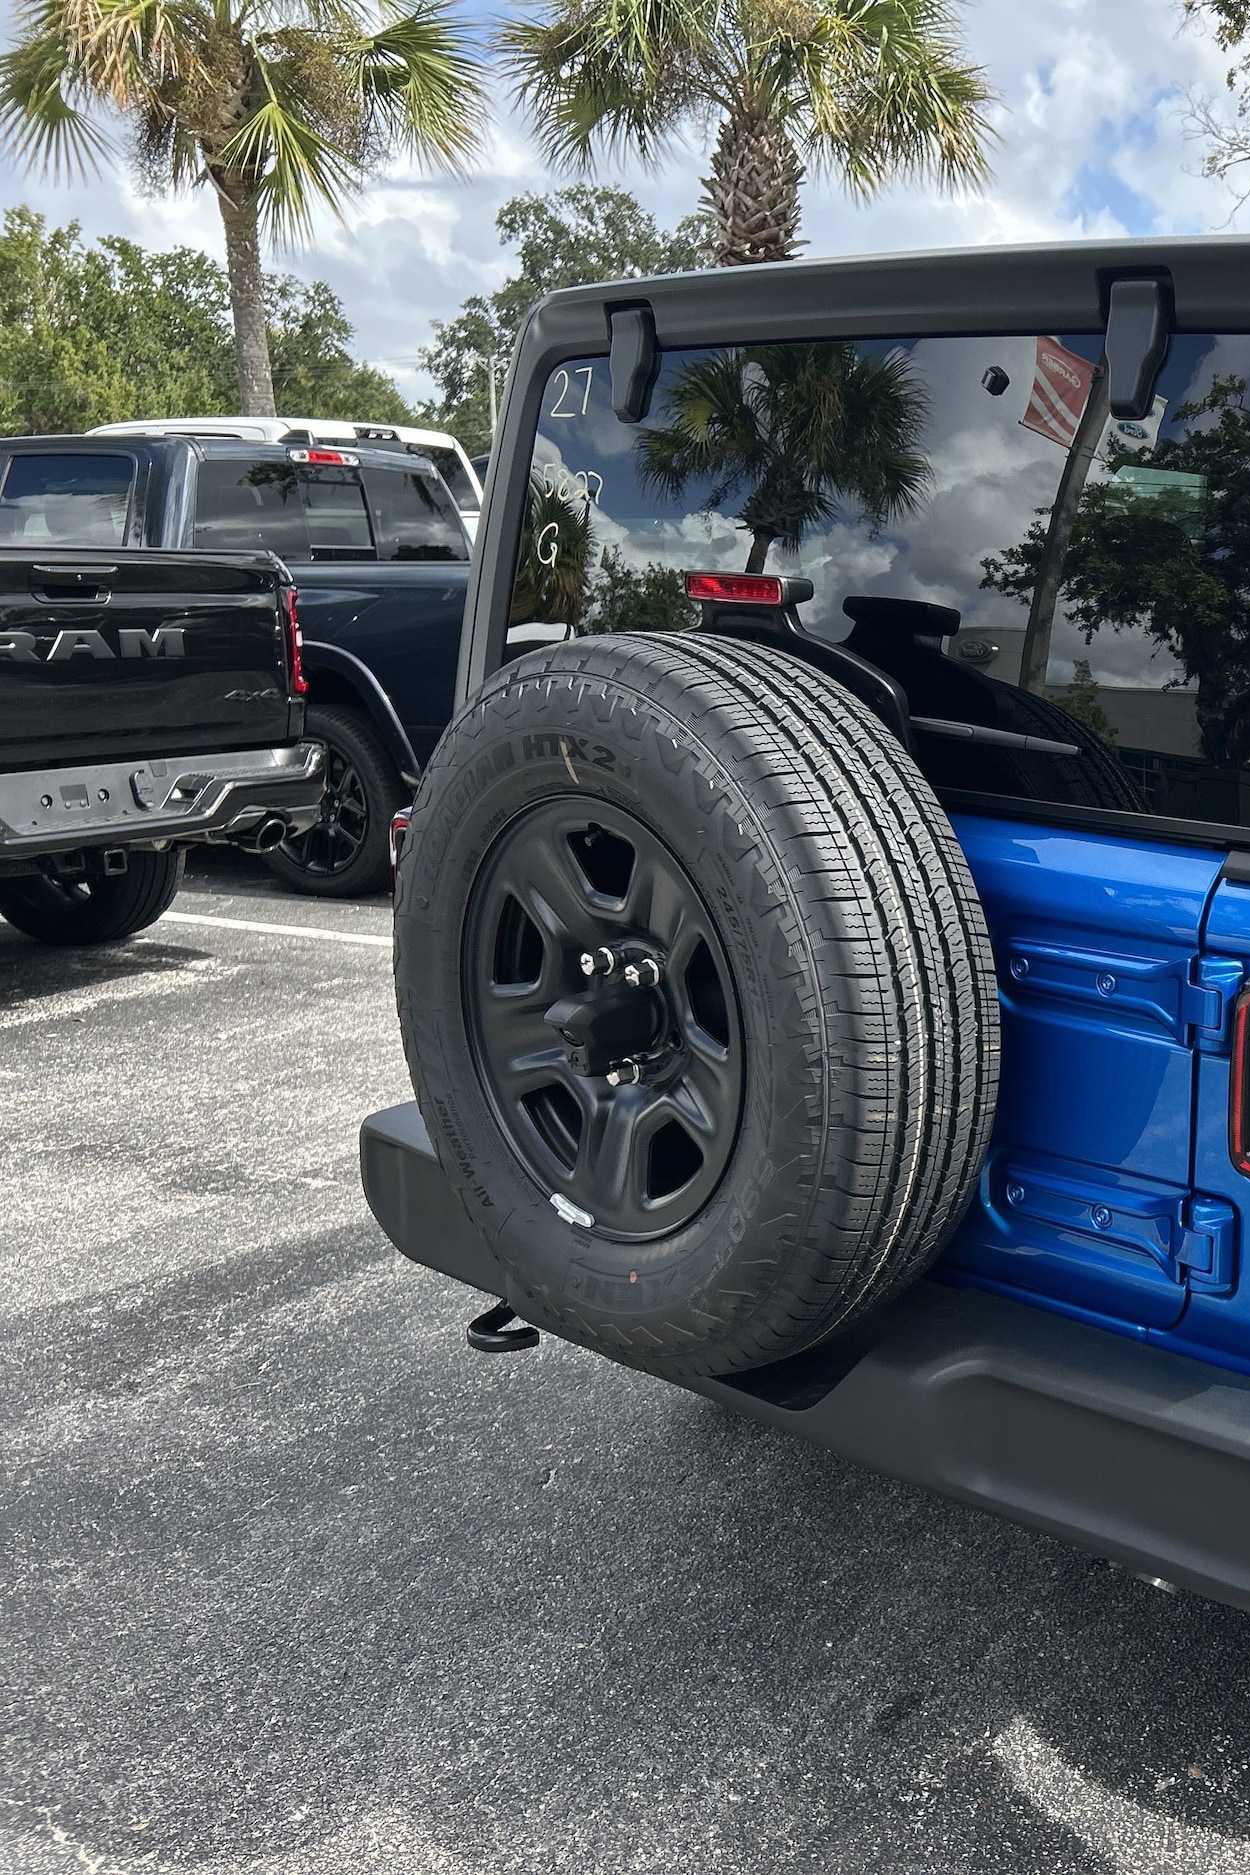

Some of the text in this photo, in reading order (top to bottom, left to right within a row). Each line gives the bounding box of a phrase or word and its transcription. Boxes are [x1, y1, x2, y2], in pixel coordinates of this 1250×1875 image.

[549, 366, 594, 418] 27
[0, 628, 186, 661] RAM
[434, 1096, 495, 1208] All-Weather
